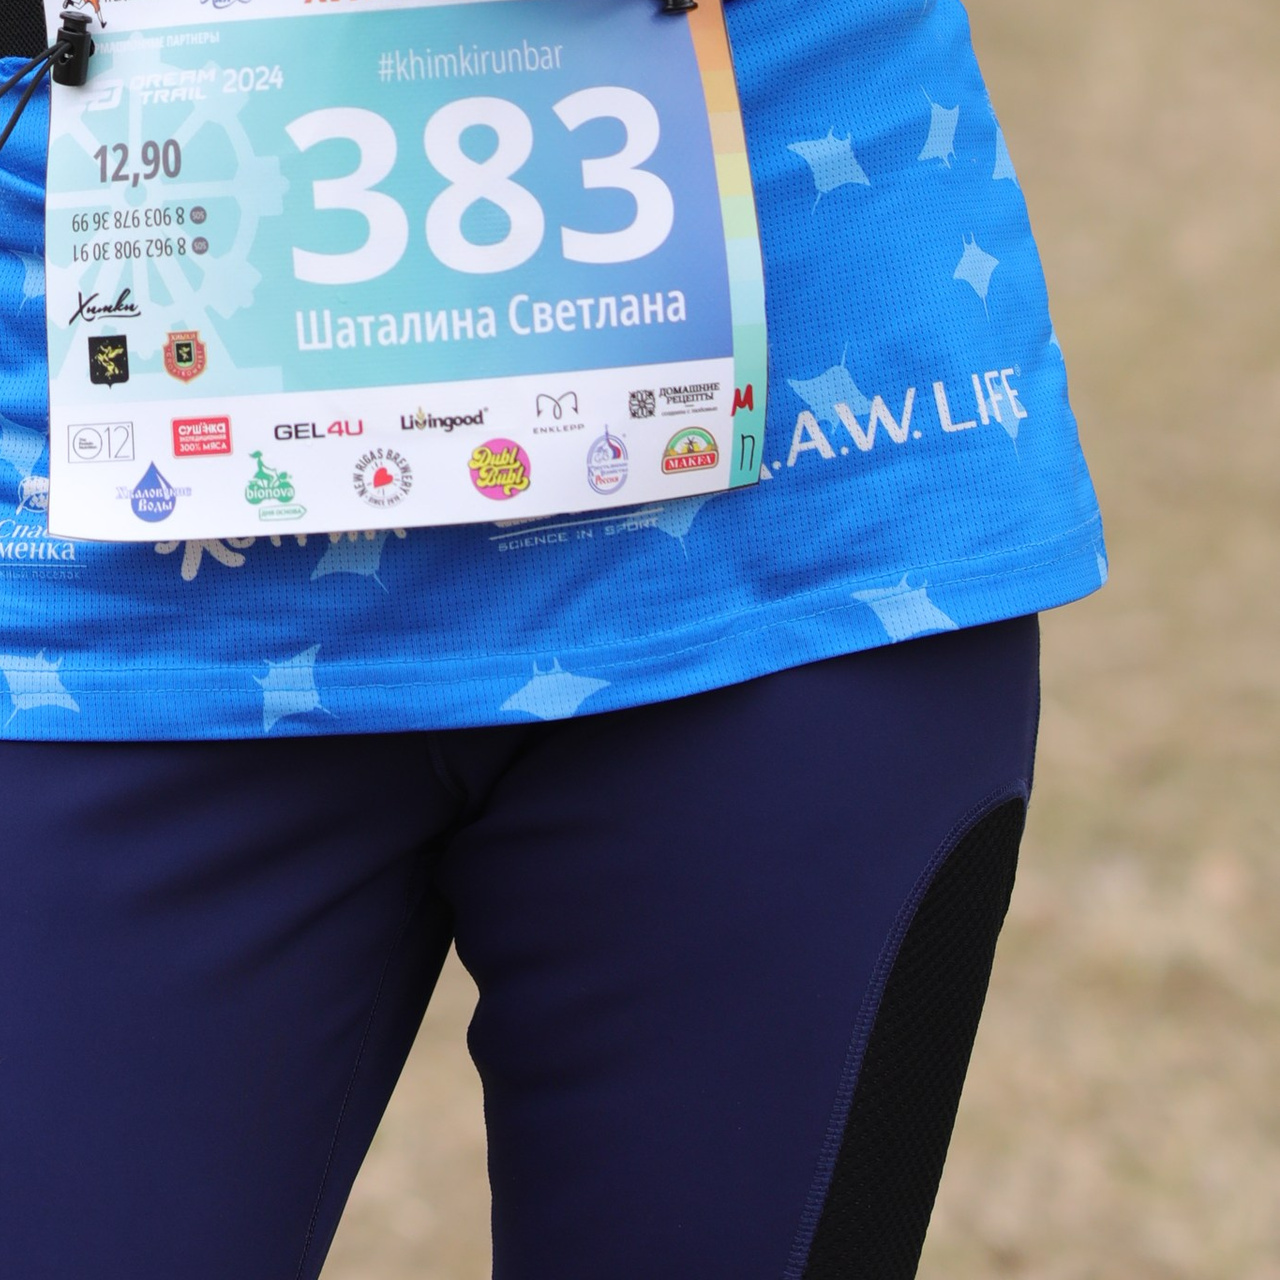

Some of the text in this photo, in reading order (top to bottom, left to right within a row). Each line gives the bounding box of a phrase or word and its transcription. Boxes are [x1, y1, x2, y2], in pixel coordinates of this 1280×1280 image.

[167, 31, 220, 47] ПАРТНЕРЫ
[378, 40, 563, 82] #khimkirunbar
[129, 65, 285, 93] DREAM 2024
[140, 87, 207, 105] TRAIL
[93, 138, 181, 188] 12,90
[285, 86, 674, 285] 383
[72, 213, 89, 233] 99
[93, 211, 110, 231] 36
[114, 209, 140, 229] 978
[144, 207, 170, 227] 903
[176, 207, 185, 225] 8
[72, 243, 89, 262] 91
[93, 242, 110, 261] 30
[114, 240, 141, 260] 908
[145, 238, 173, 258] 962
[177, 237, 186, 256] 8
[296, 290, 687, 351] Шаталина Светлана
[659, 382, 720, 398] ДОМАШНИЕ
[932, 368, 1027, 433] LIFE
[274, 419, 364, 441] GEL4U
[401, 408, 484, 432] Livingood
[533, 423, 585, 434] ENKLEPP
[353, 448, 413, 497] NEW RIGAS BREWERY
[246, 481, 295, 500] bionova
[498, 533, 568, 552] SCIENCE
[576, 528, 593, 540] IN
[605, 517, 659, 536] SPORT
